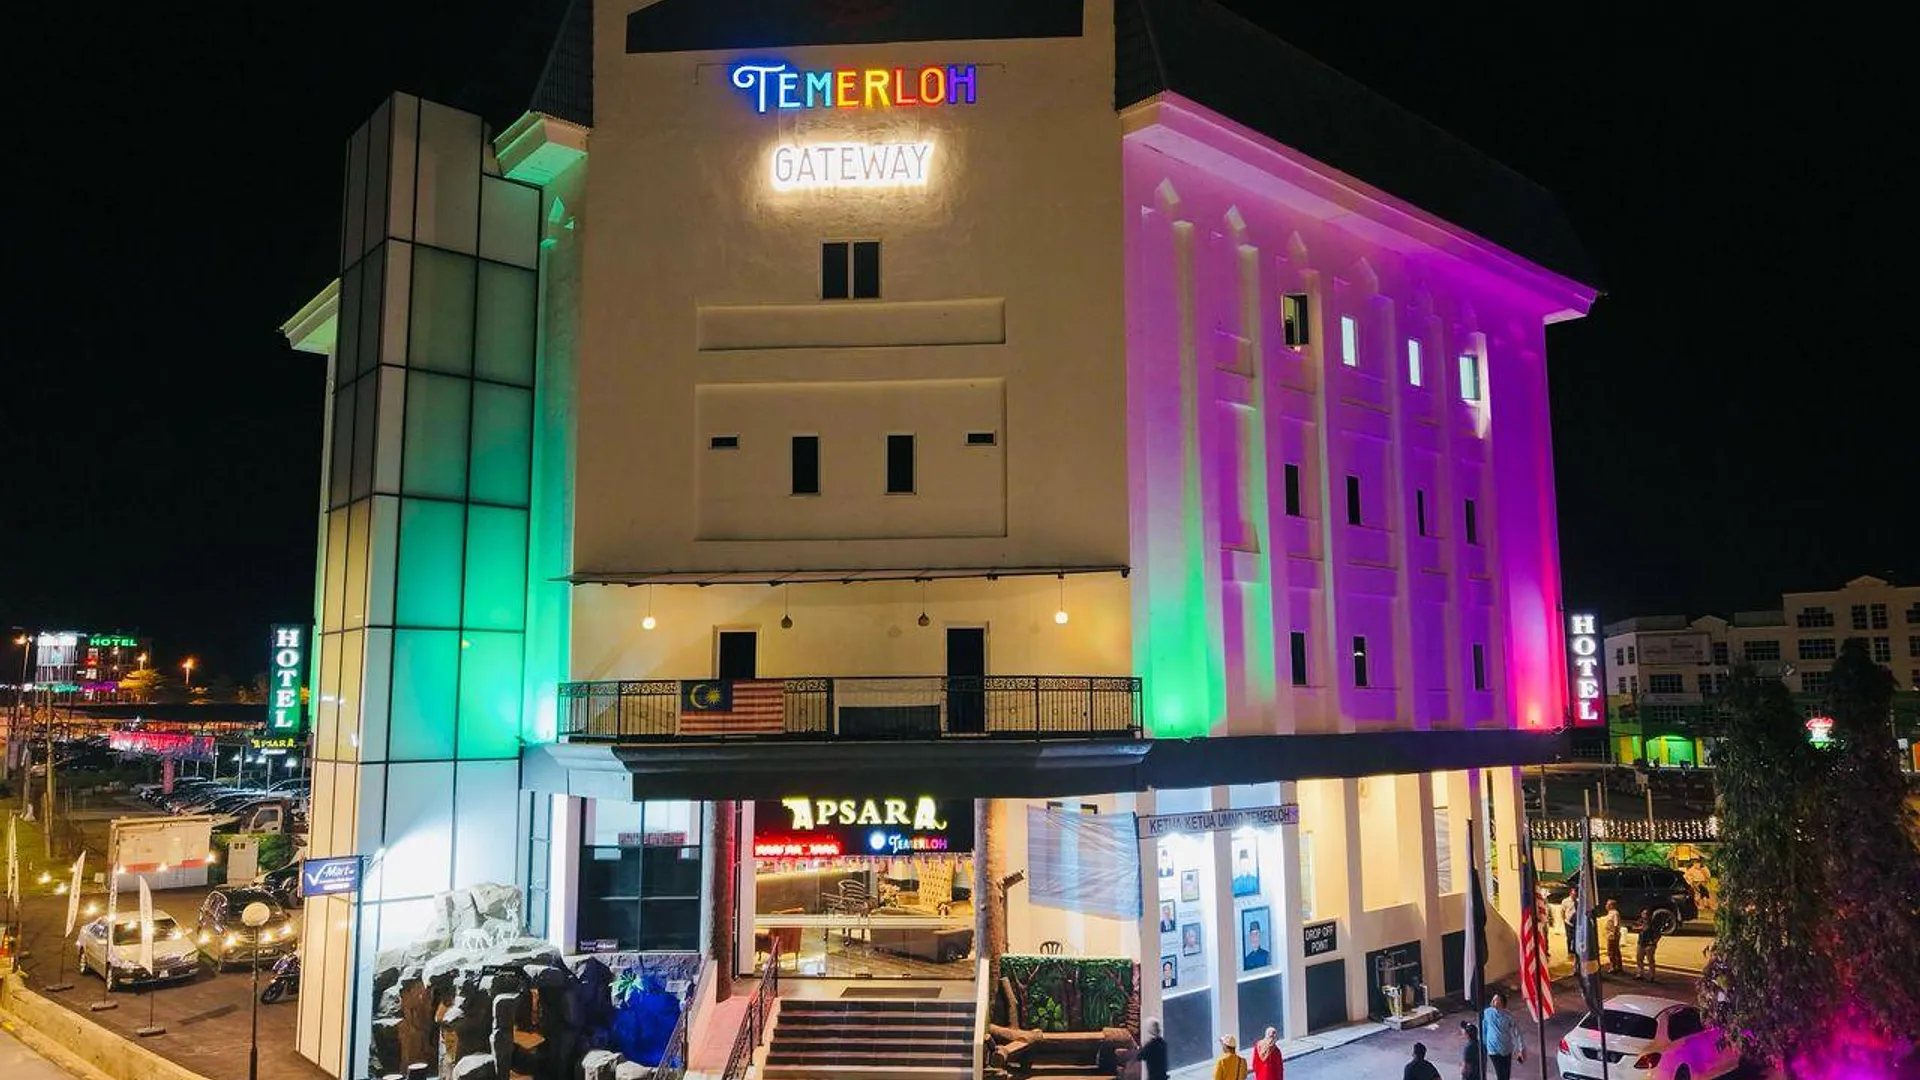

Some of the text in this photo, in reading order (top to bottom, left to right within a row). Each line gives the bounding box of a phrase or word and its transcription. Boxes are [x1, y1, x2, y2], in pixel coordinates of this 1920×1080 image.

[732, 64, 976, 113] TEMERLOH
[775, 145, 928, 182] GATEWAY
[89, 637, 138, 647] HOTEL
[275, 628, 300, 728] HOTEL
[1571, 614, 1599, 720] HOTEL
[782, 796, 947, 830] APSARA
[1184, 813, 1217, 830] KETUA
